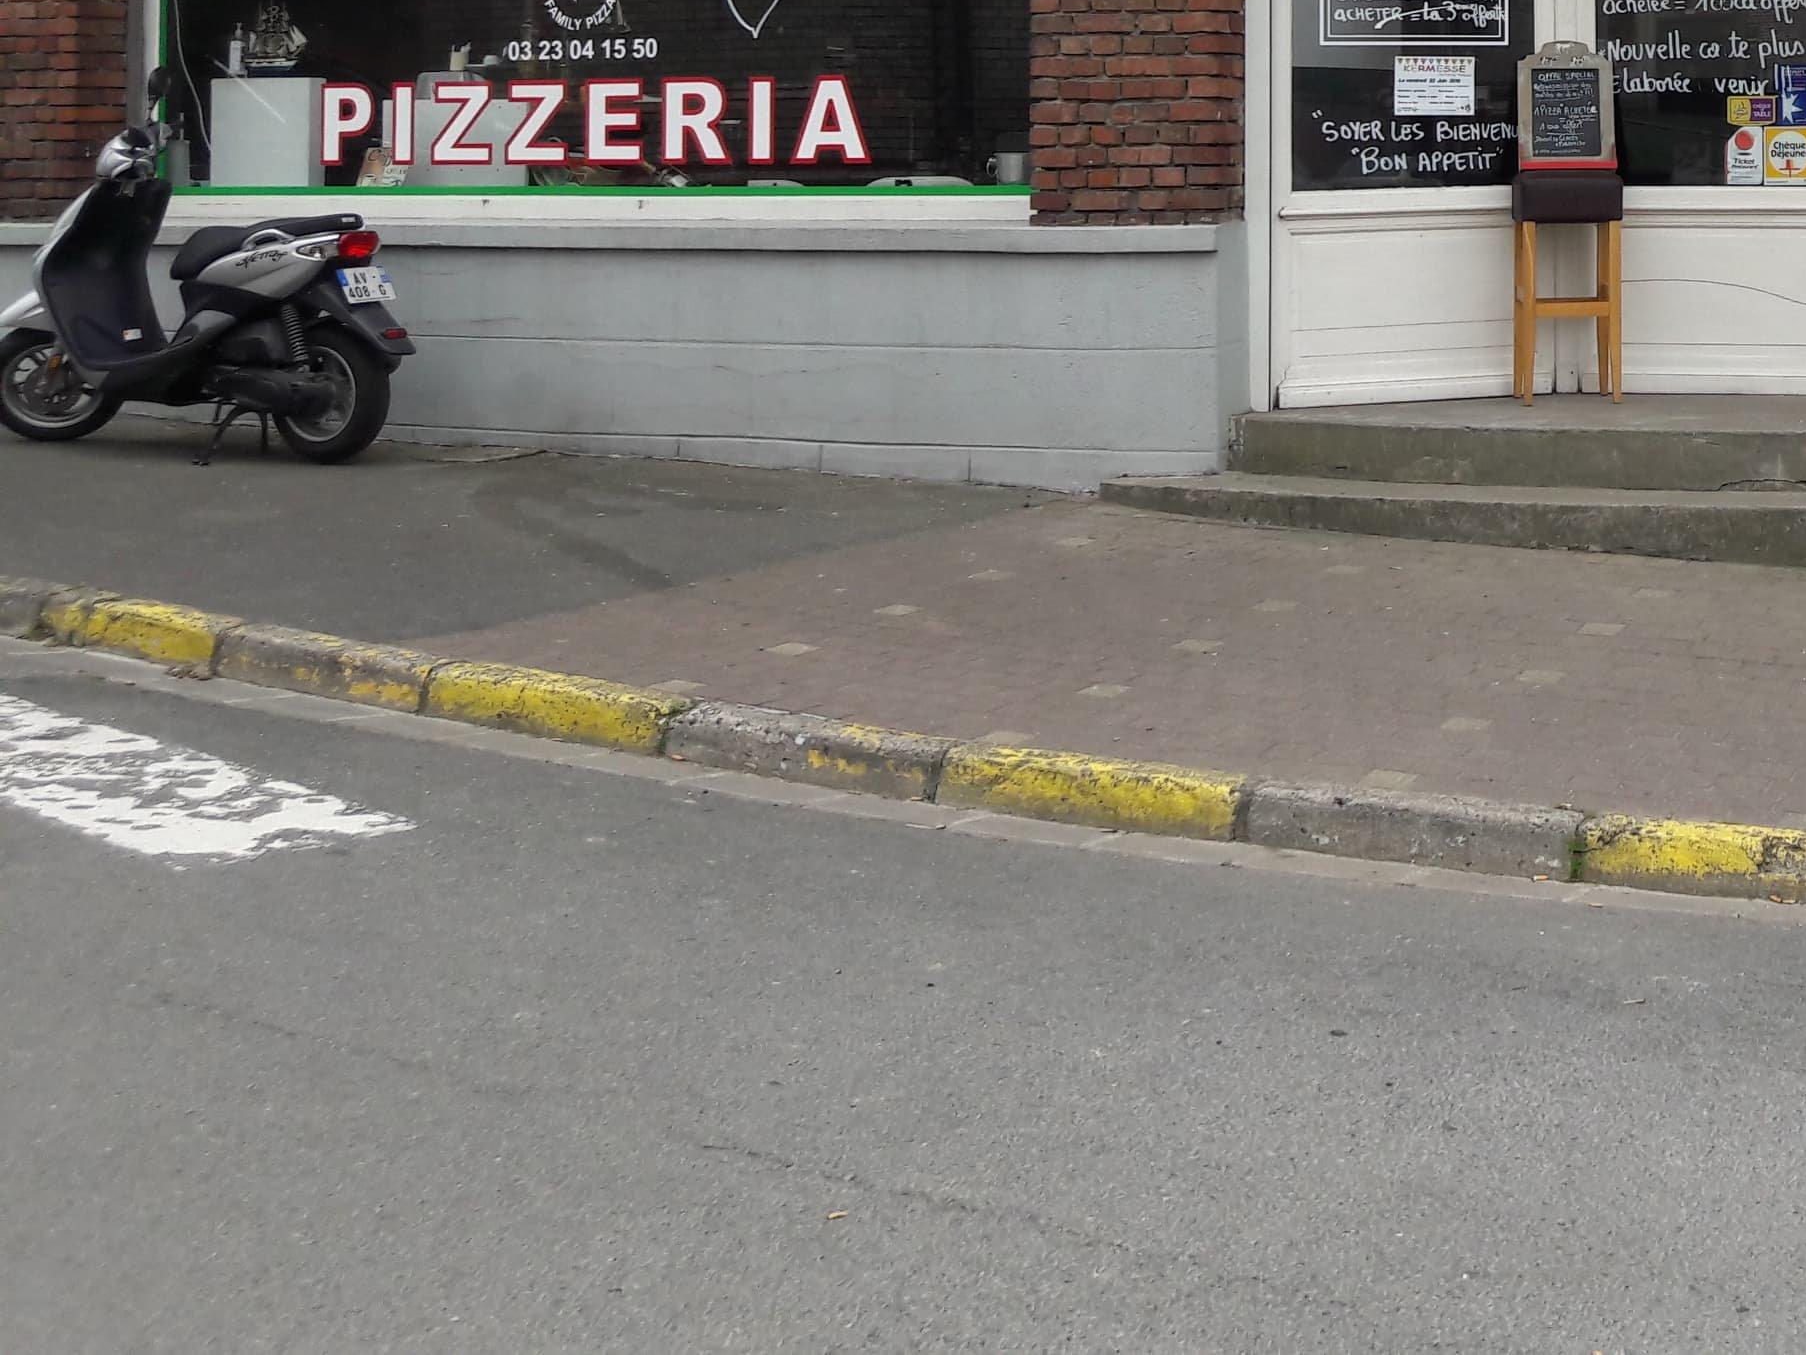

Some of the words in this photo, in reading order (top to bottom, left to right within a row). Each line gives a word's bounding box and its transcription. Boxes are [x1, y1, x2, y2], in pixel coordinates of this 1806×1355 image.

[507, 40, 532, 61] 03
[538, 40, 563, 60] 23
[569, 39, 594, 60] 04
[601, 38, 626, 59] 15
[632, 38, 658, 59] 50
[1607, 29, 1692, 61] Nouvelle
[1758, 29, 1805, 68] plus
[1403, 64, 1466, 73] KERMESSE
[1714, 74, 1768, 95] venir
[320, 75, 872, 166] PIZZERIA
[1773, 140, 1806, 151] Chèque
[1734, 157, 1755, 165] Ticket
